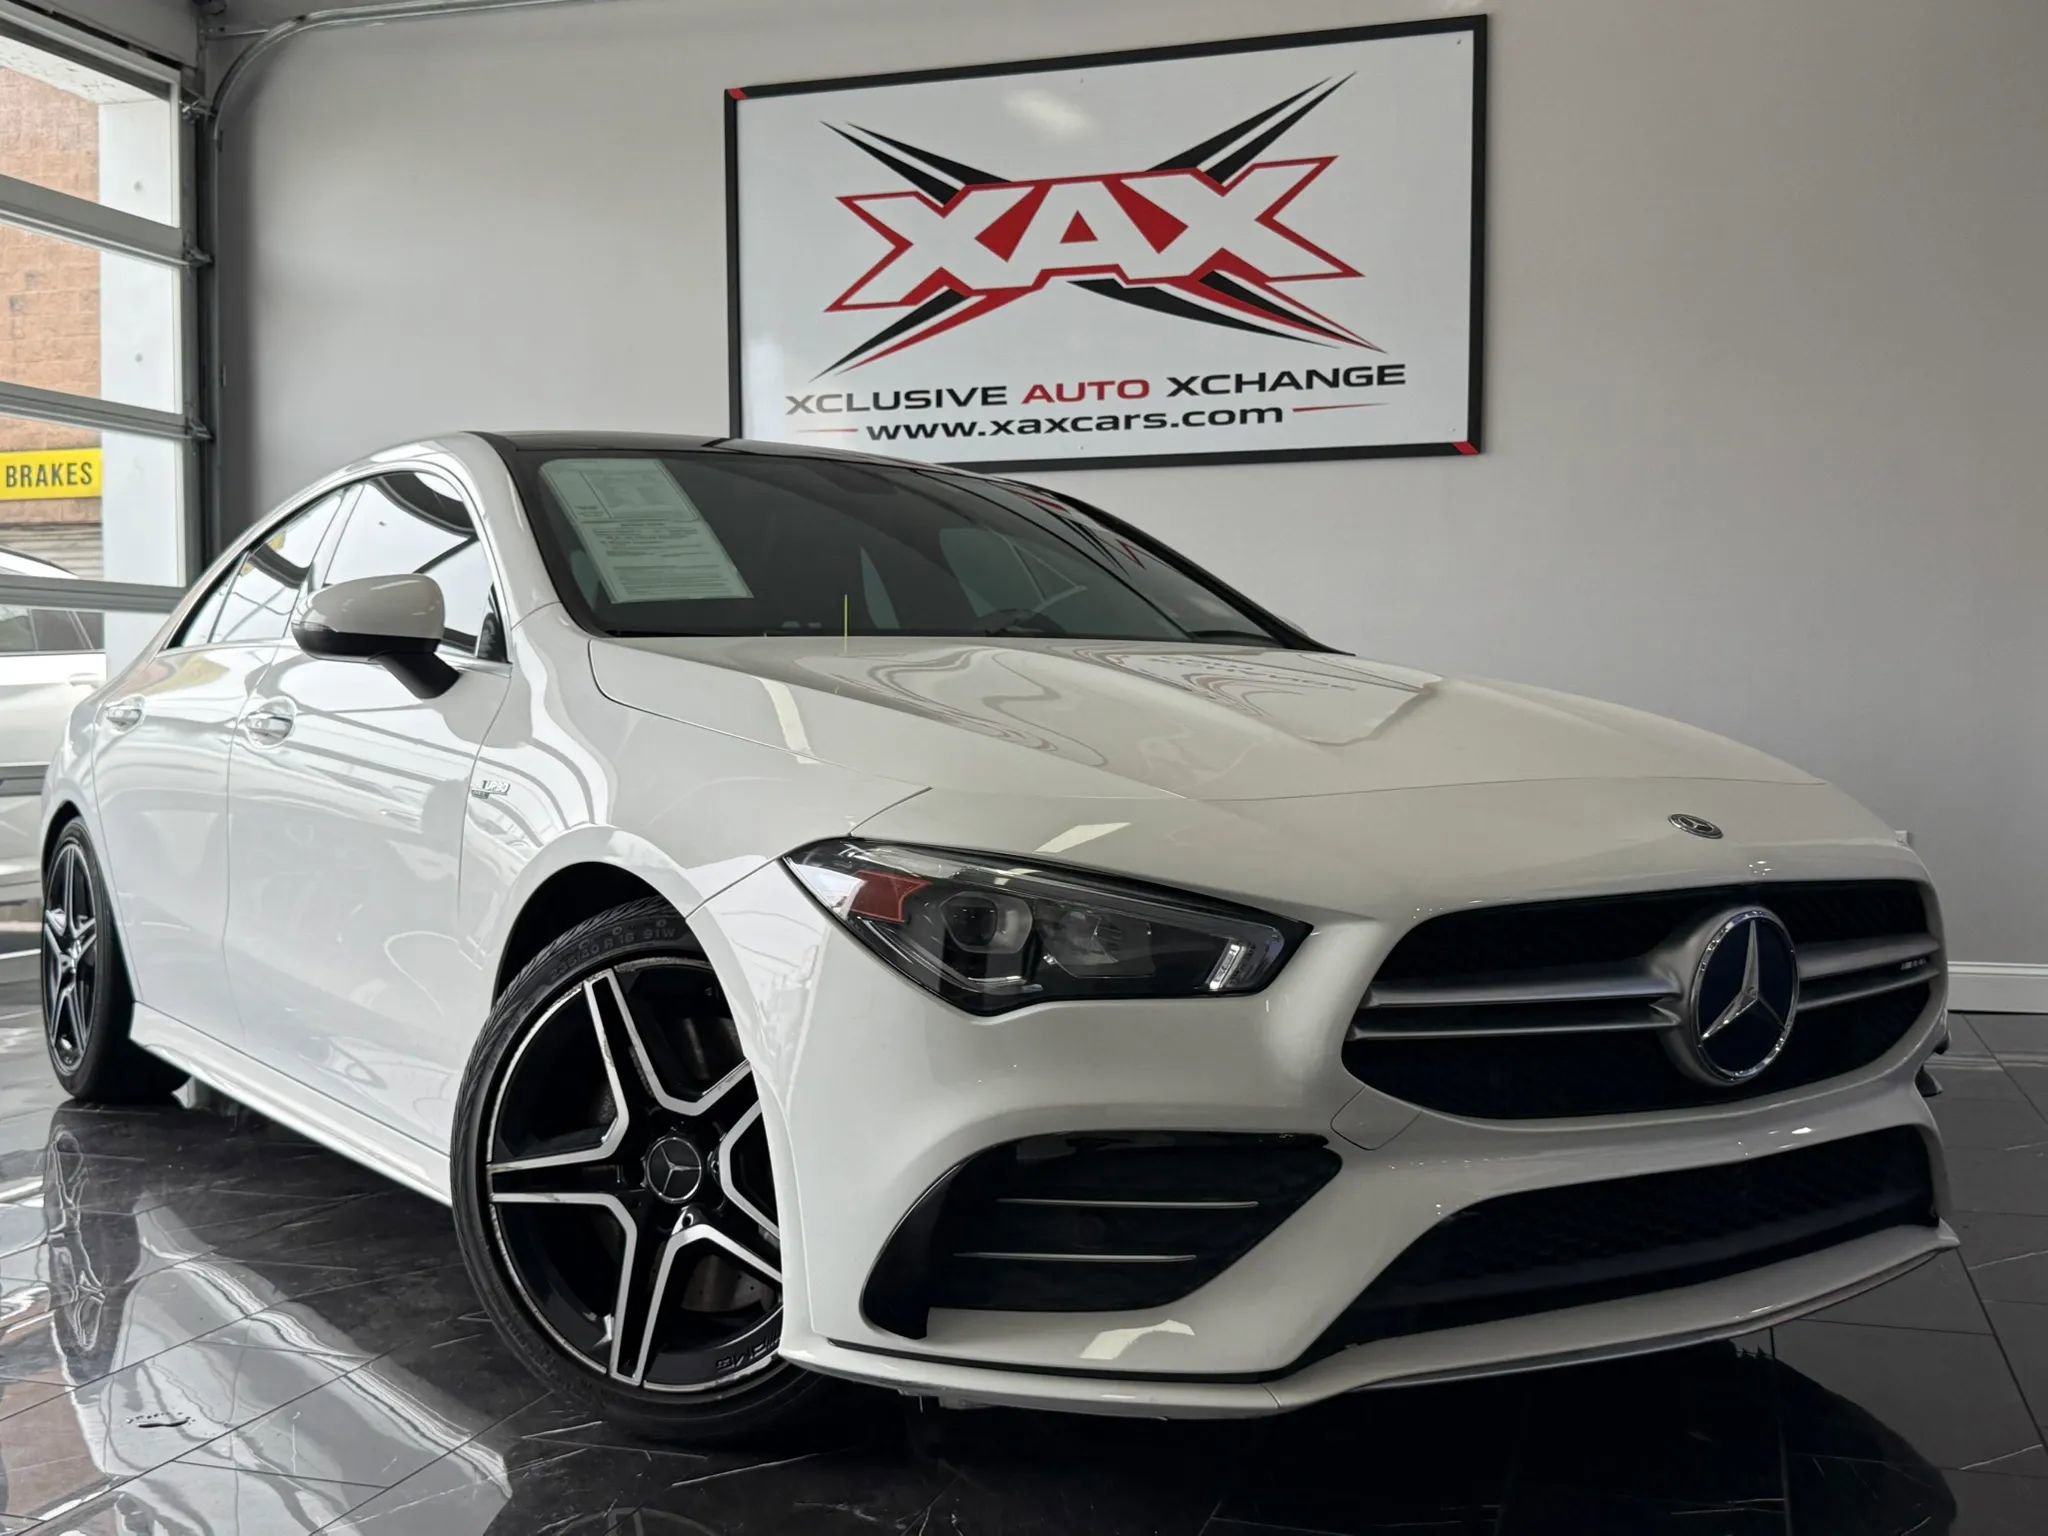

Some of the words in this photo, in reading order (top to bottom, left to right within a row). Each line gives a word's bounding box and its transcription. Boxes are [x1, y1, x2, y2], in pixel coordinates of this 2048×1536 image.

[823, 155, 1366, 313] XAX
[785, 385, 1008, 416] XCLUSIVE
[1021, 378, 1150, 405] AUTO
[1166, 363, 1407, 398] XCHANGE
[866, 406, 1284, 441] www.xaxcars.com
[5, 461, 94, 489] BRAKES
